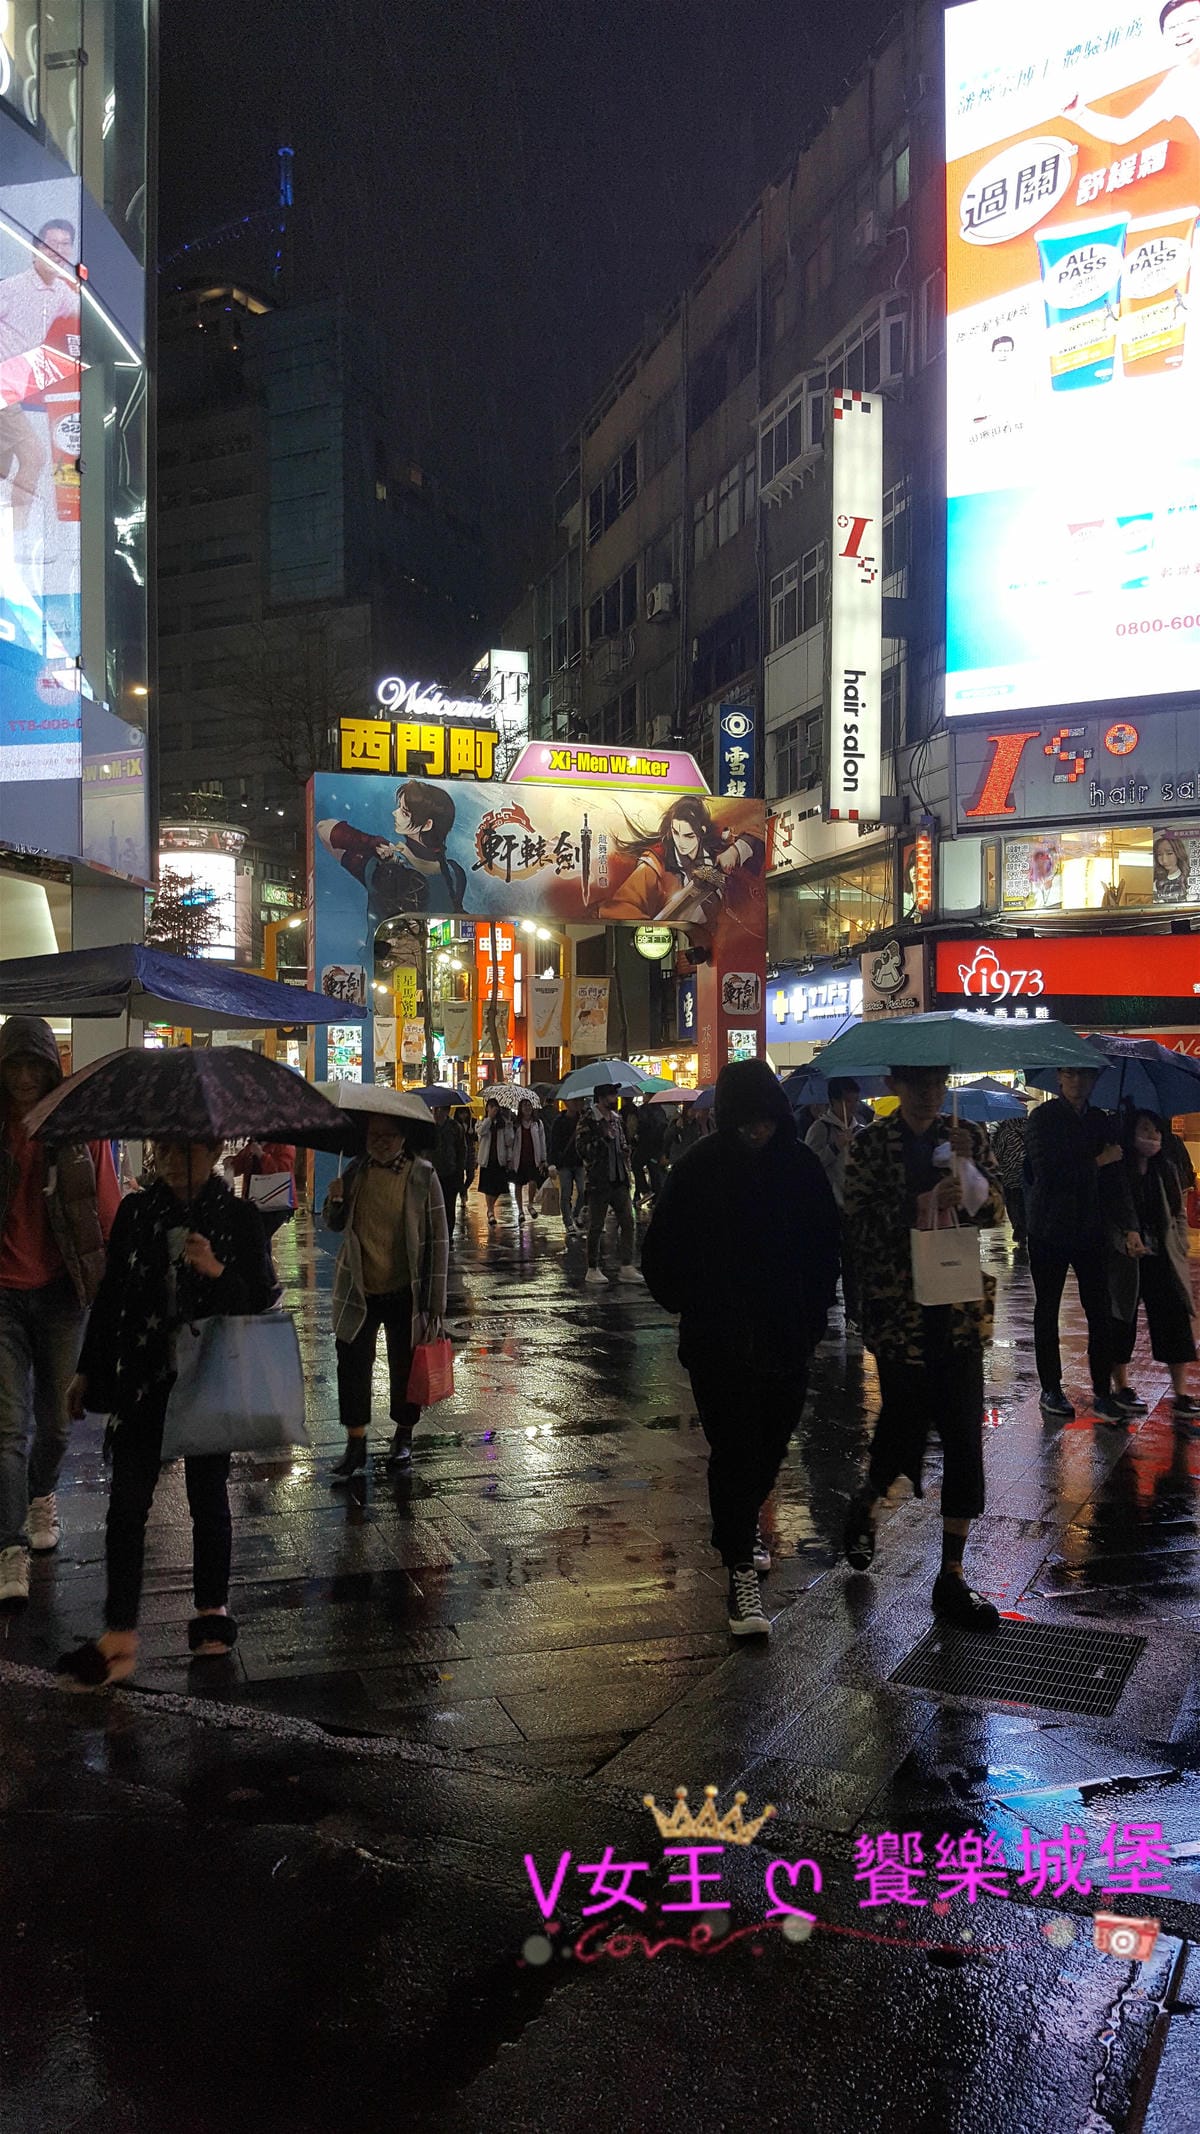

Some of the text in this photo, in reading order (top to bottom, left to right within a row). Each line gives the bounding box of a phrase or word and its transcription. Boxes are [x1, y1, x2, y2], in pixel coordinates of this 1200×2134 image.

[964, 153, 1060, 232] 過關
[1065, 248, 1098, 268] ALL
[1129, 250, 1177, 275] PASS
[1136, 240, 1168, 260] ALL
[1058, 258, 1107, 284] PASS
[377, 676, 501, 719] Welcome
[842, 669, 867, 792] hair salon
[339, 717, 499, 779] 西門町
[549, 750, 670, 777] Xi-Men Walker
[1090, 779, 1149, 806] hair
